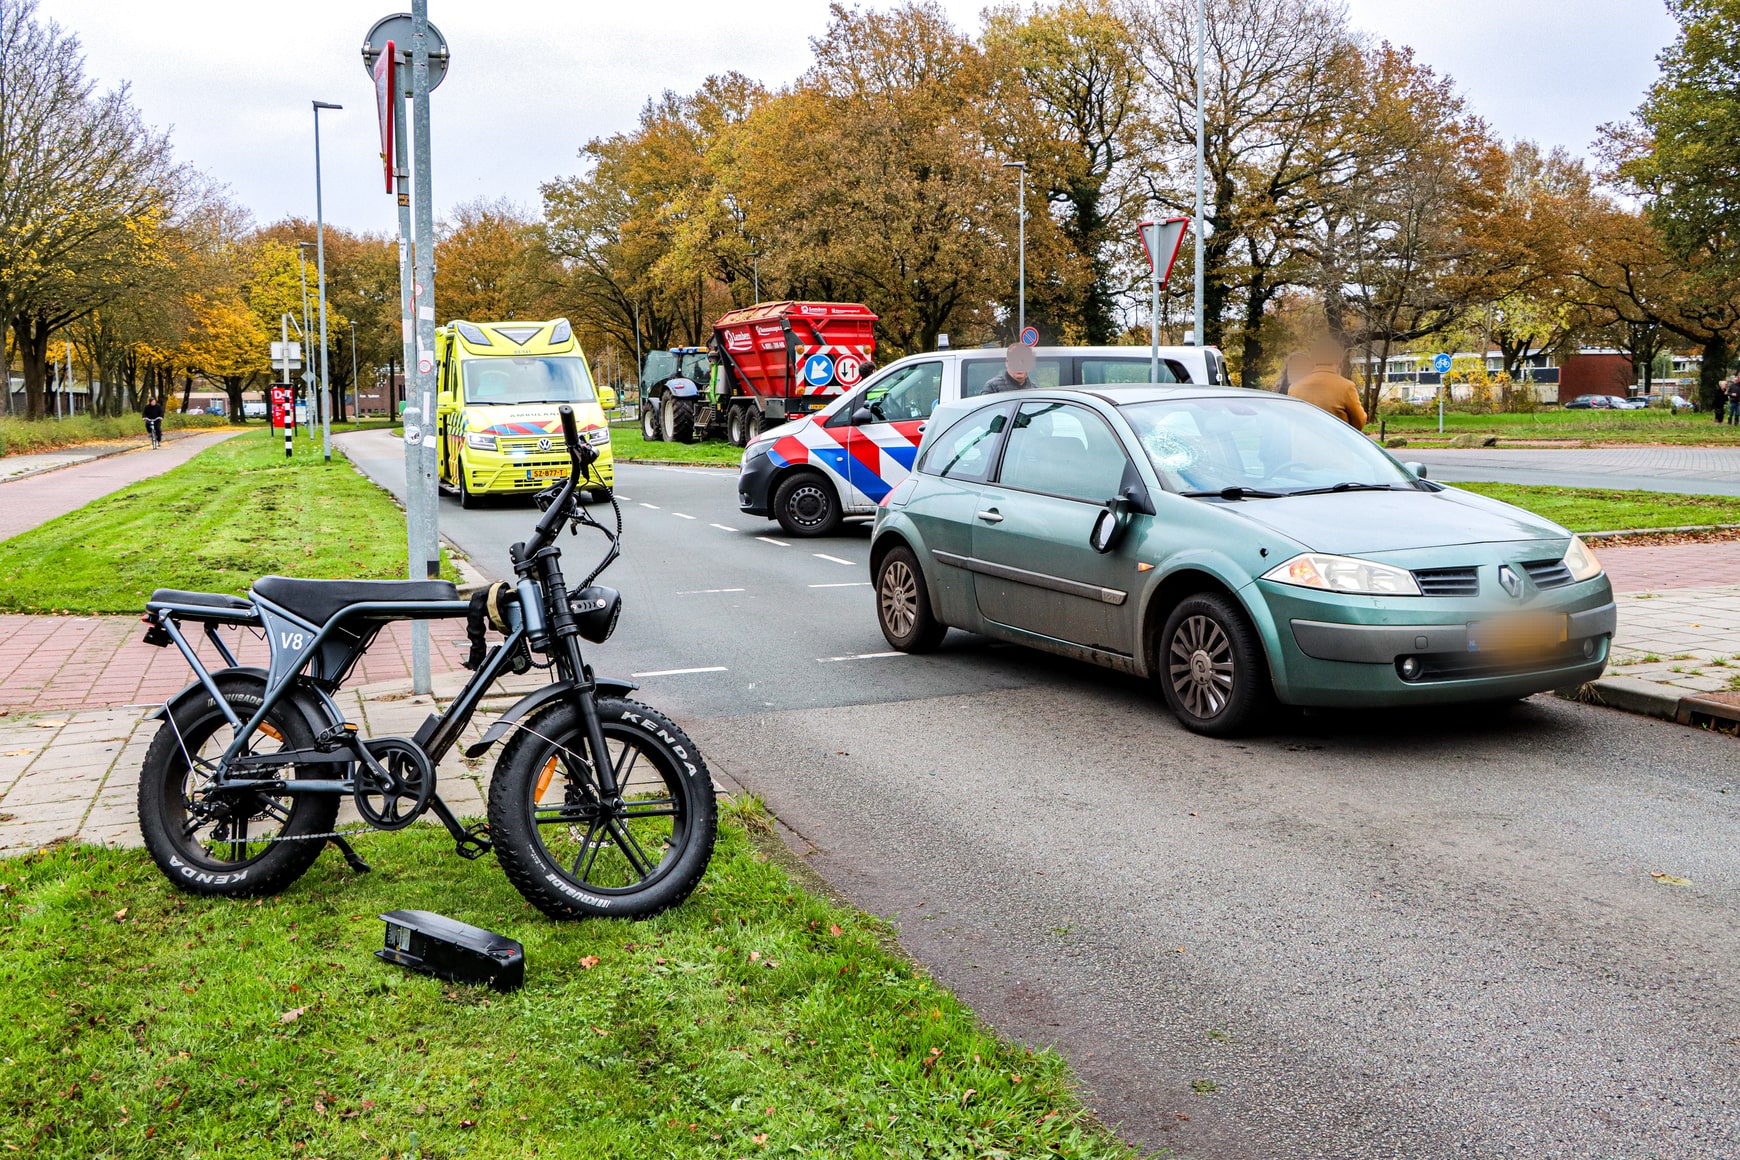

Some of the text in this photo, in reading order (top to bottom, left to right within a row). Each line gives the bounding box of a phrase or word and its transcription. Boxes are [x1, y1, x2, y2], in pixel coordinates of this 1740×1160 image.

[281, 632, 304, 650] V8
[620, 711, 698, 777] KENDA
[169, 855, 249, 885] KENDA
